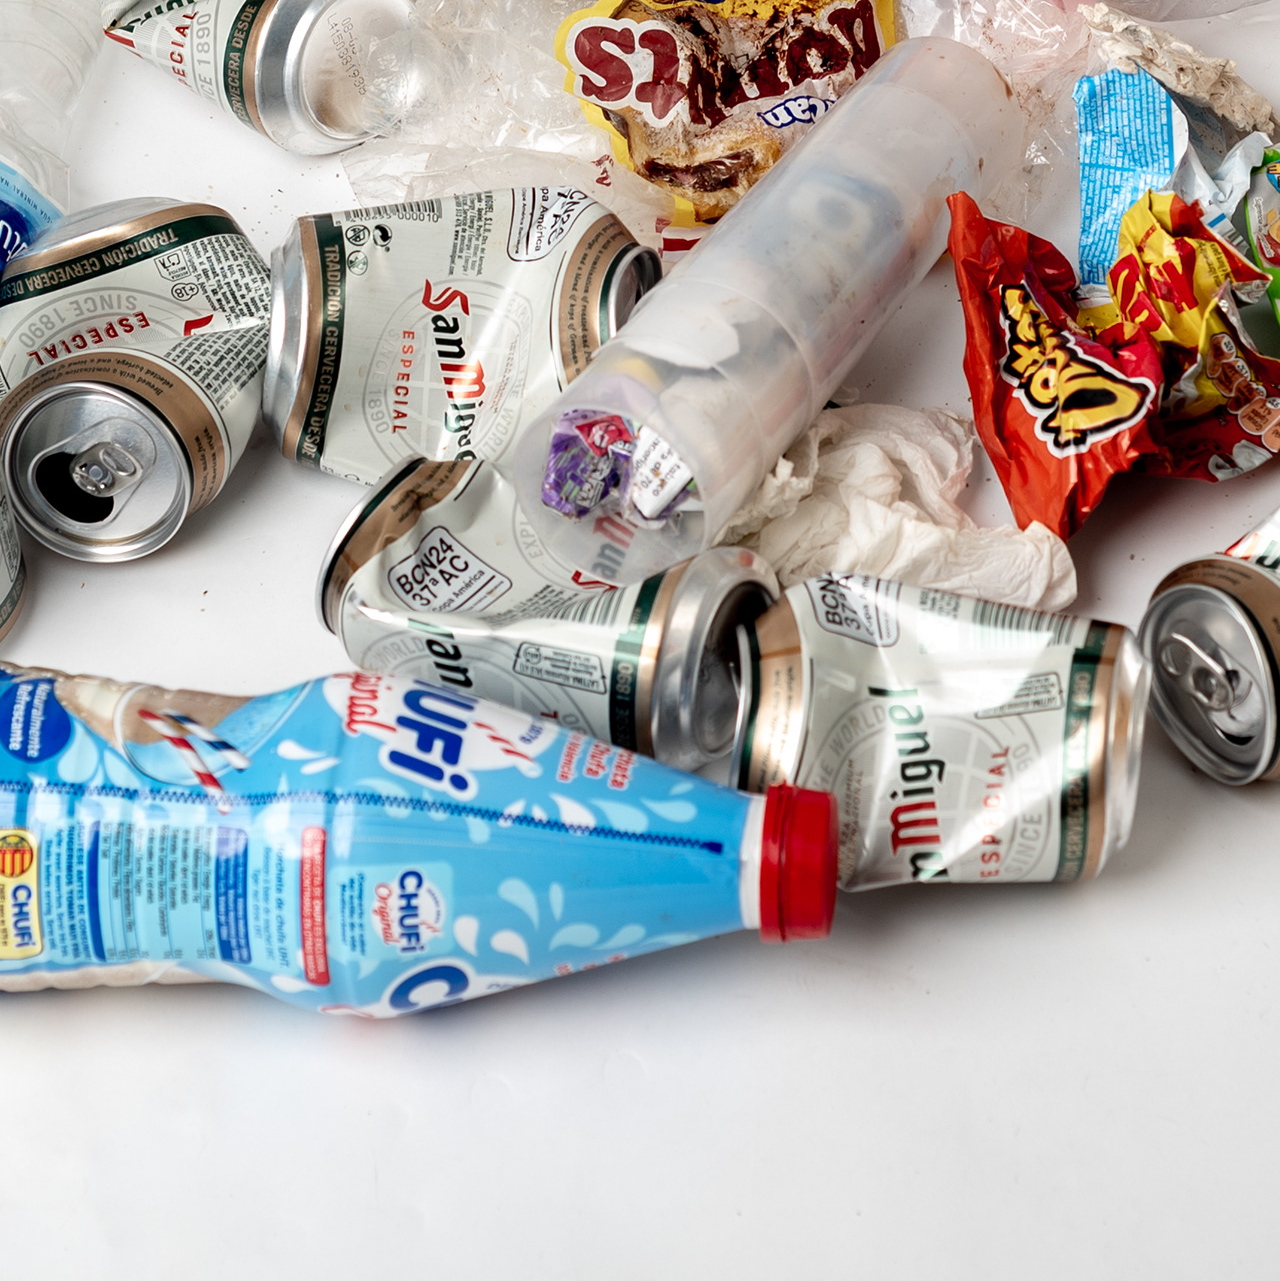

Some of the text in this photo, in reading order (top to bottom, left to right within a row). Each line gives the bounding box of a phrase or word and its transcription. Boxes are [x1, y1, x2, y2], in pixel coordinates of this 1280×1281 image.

[196, 12, 212, 62] 1890
[232, 2, 260, 49] DESDE
[534, 204, 550, 253] América
[24, 227, 180, 293] TRADICIÓN CERVECERA
[173, 282, 198, 299] +18
[322, 244, 340, 323] TRADICIÓN
[18, 292, 138, 350] SINCE 1890
[26, 311, 151, 367] ESPECIAL
[309, 325, 341, 415] CERVECERA
[391, 329, 416, 435] ESPECIAL
[395, 535, 456, 597] BCN24
[440, 554, 471, 586] AC
[452, 568, 487, 600] América
[9, 683, 35, 752] Refrescante
[27, 681, 52, 759] Naturalmente
[979, 745, 1011, 880] ESPECIAL
[373, 882, 400, 946] Original
